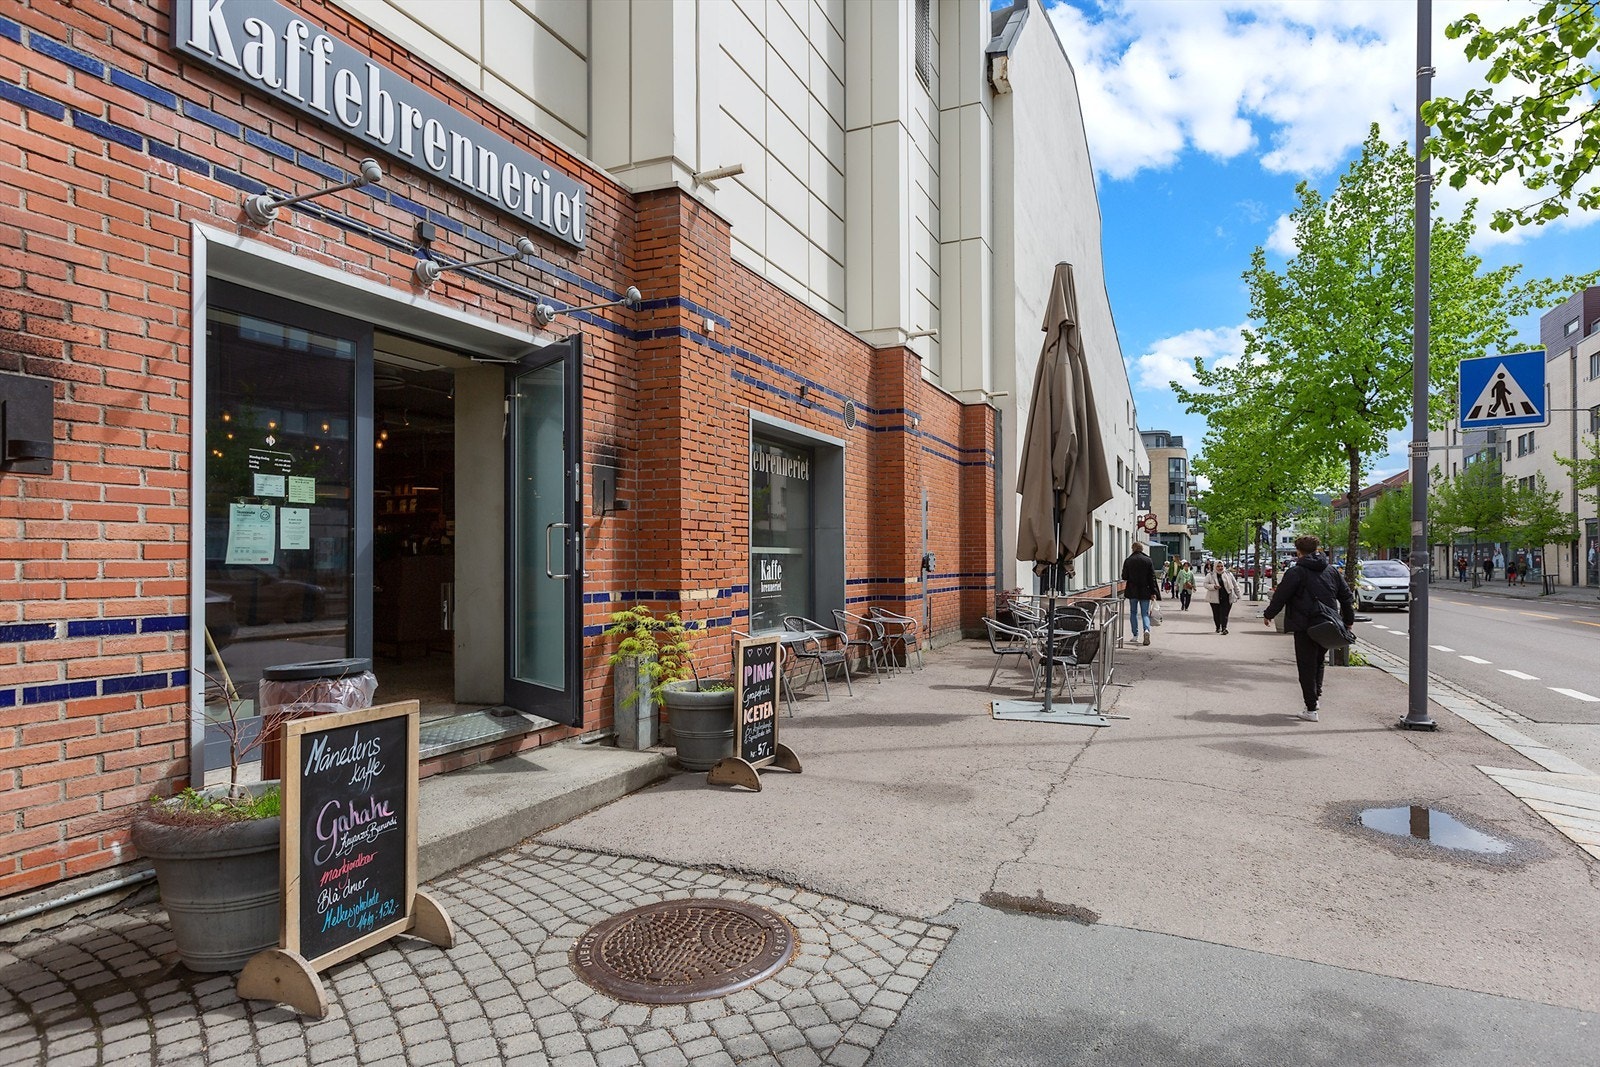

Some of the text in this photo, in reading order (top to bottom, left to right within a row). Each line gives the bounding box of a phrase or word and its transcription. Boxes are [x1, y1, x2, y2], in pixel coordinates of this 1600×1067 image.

[186, 0, 585, 244] Kaffebrenneriet
[760, 559, 782, 581] Kaffe
[744, 661, 775, 687] PINK
[743, 701, 774, 725] ICETEA
[304, 730, 382, 777] Månedens
[348, 757, 386, 794] kaffe
[317, 877, 369, 914] Blå druer
[577, 932, 599, 967] ULEFOS
